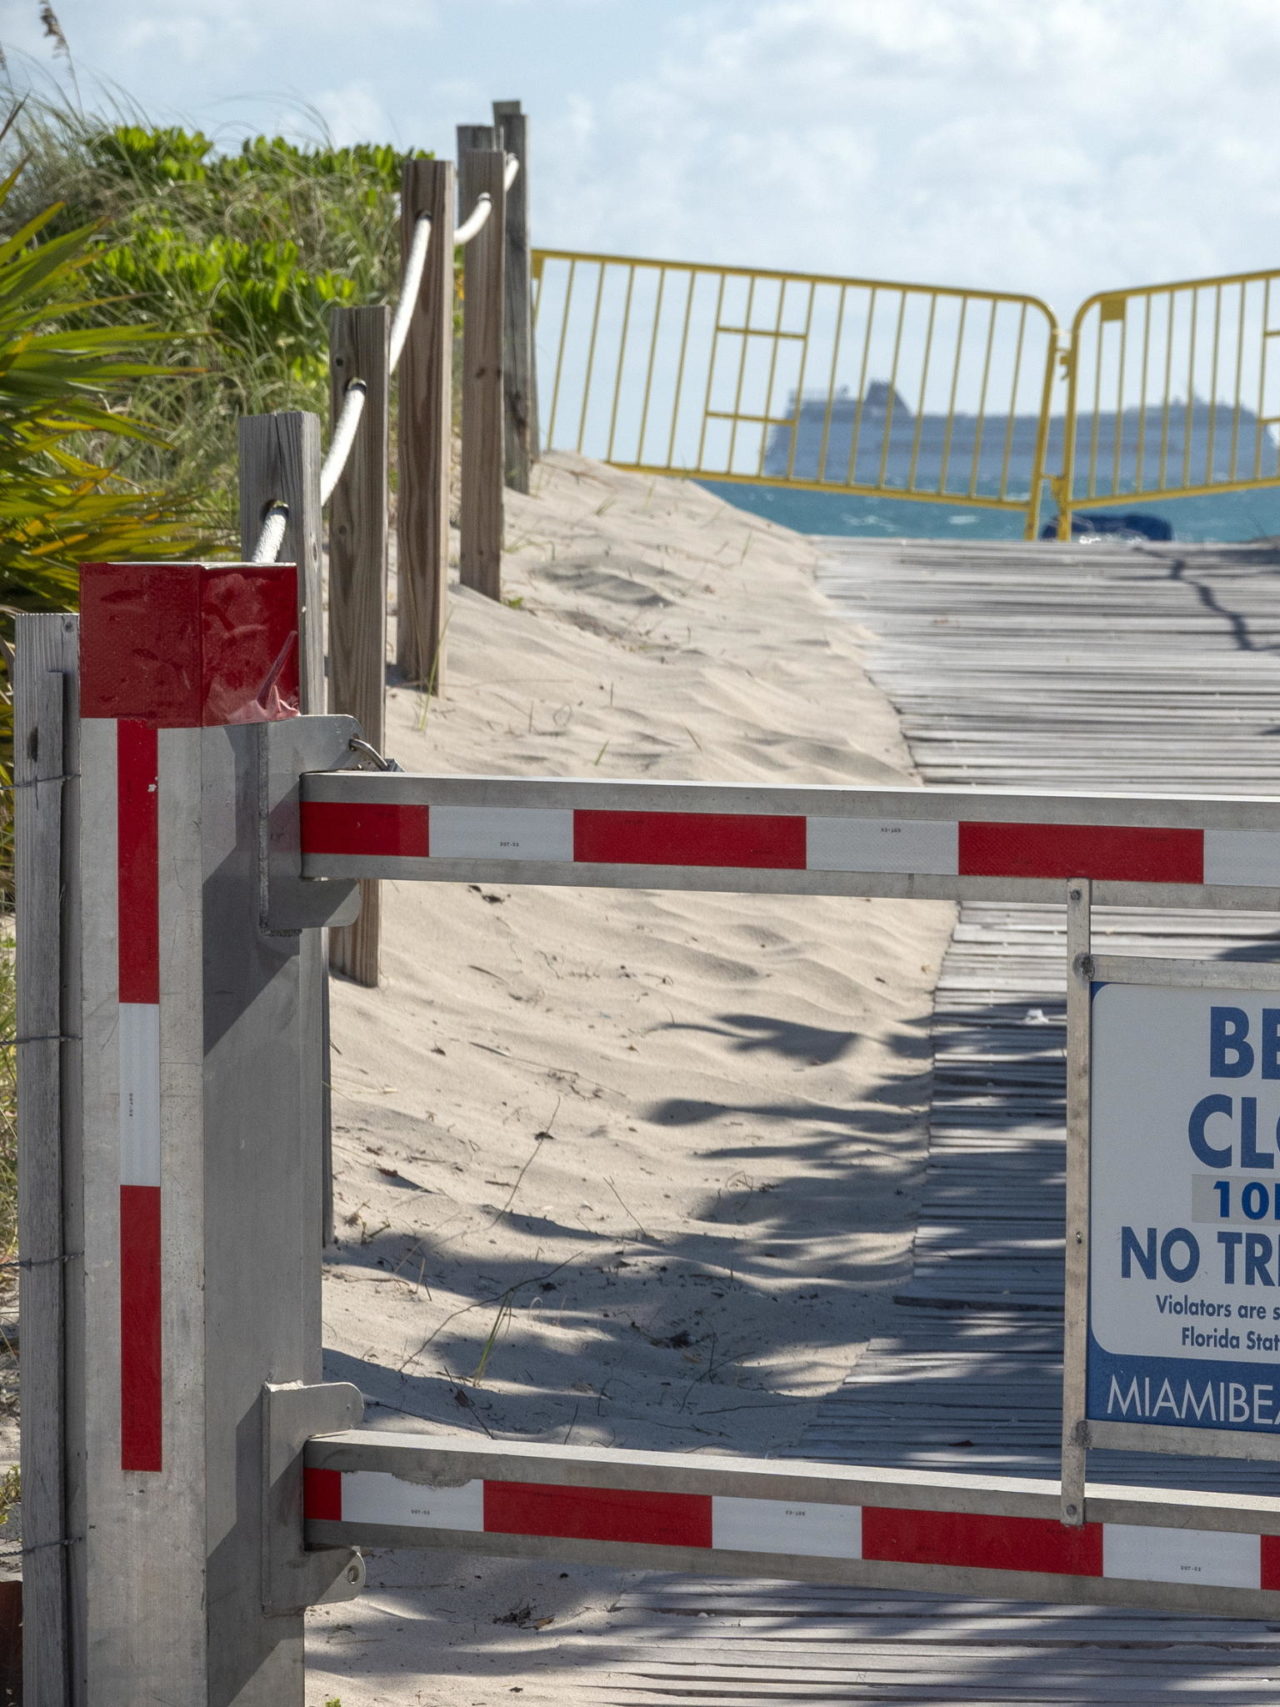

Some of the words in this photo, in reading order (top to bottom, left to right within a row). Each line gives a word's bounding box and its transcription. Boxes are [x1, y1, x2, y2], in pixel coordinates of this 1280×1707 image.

[1122, 1227, 1200, 1283] NO
[1156, 1295, 1231, 1317] Violators
[1238, 1305, 1266, 1319] are
[1182, 1326, 1239, 1349] Florida
